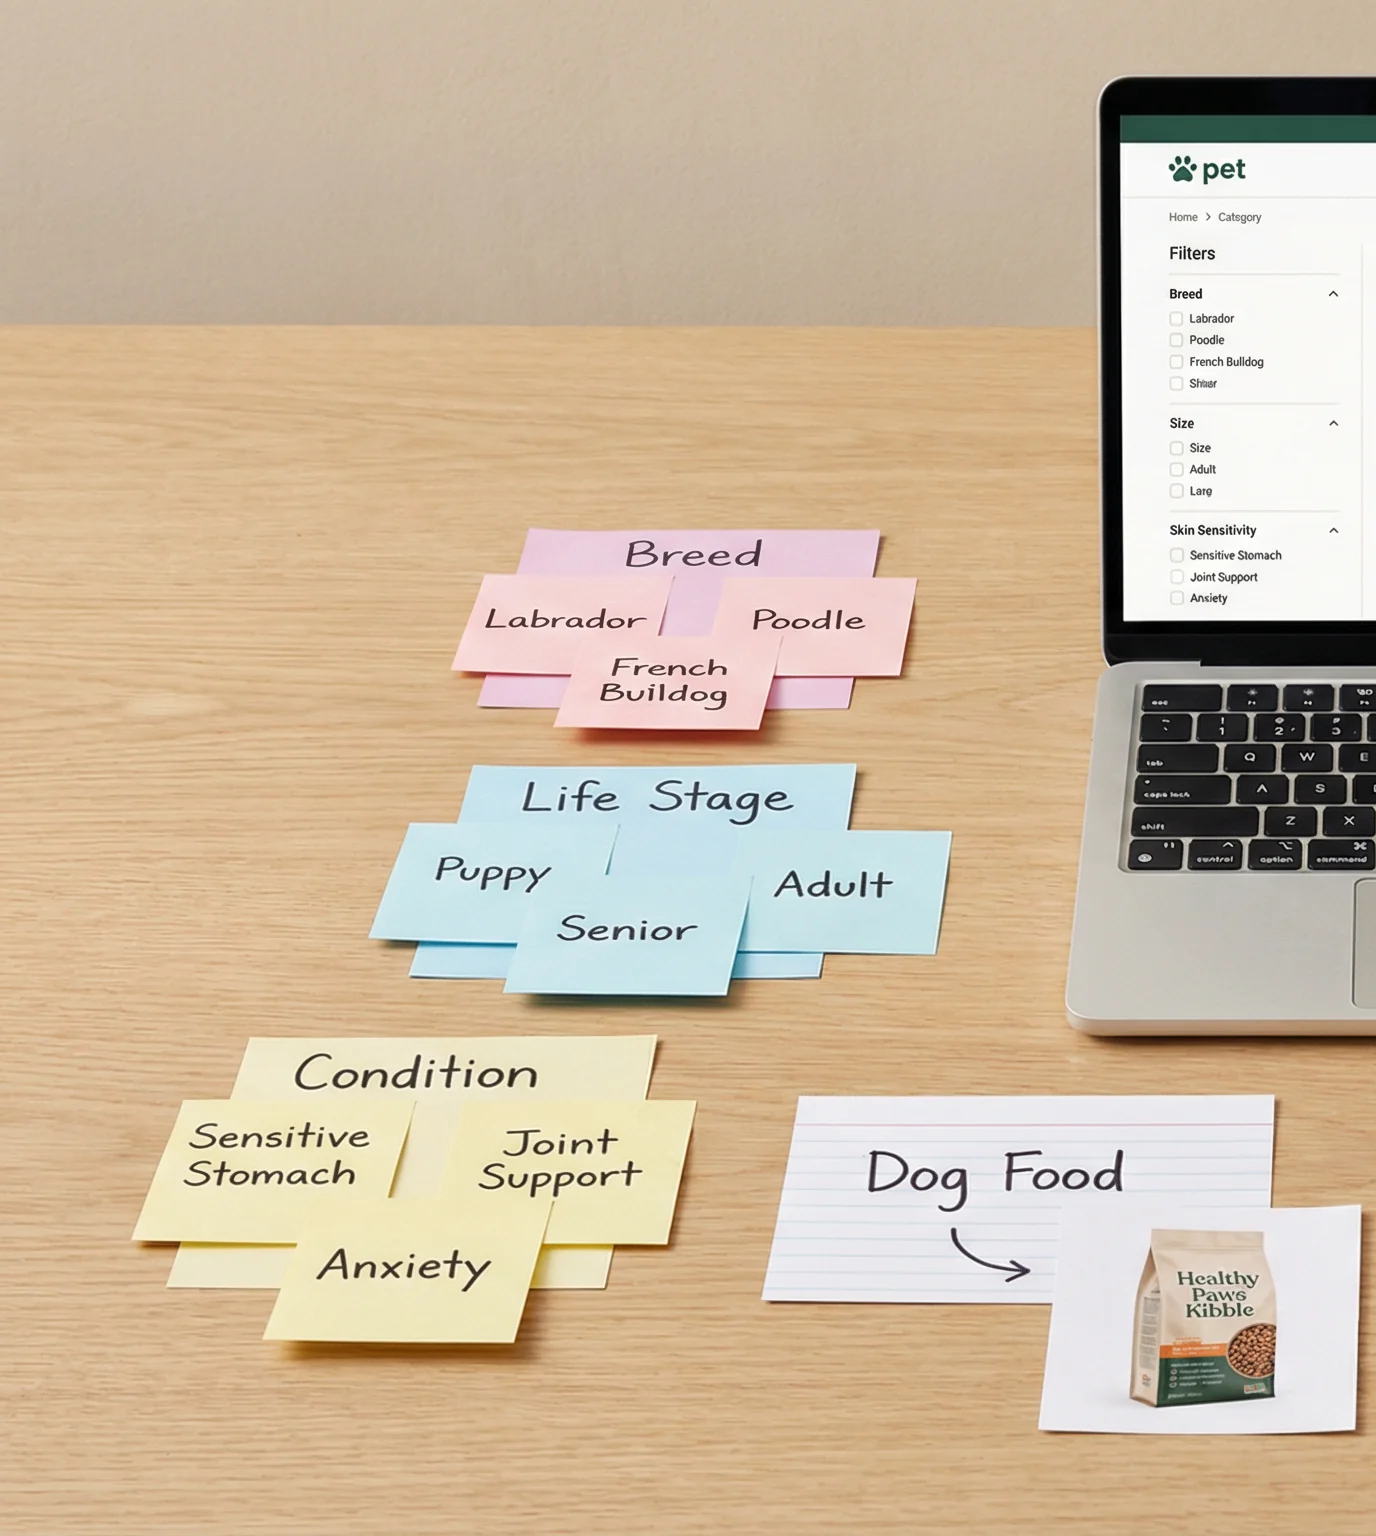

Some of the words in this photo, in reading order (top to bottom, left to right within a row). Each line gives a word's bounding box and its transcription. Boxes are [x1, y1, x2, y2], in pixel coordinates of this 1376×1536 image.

[1203, 159, 1245, 185] pet
[1169, 212, 1199, 222] Home
[1170, 246, 1215, 260] Filters
[1169, 287, 1203, 300] Breed
[1189, 312, 1235, 324] Labrador
[1189, 356, 1224, 367] French
[1226, 356, 1264, 370] Bulldog
[1169, 417, 1195, 429] Size
[1189, 442, 1212, 454] Size
[1189, 463, 1217, 475] Adult
[1169, 523, 1195, 536] Skin
[1197, 524, 1257, 539] Sensitivity
[626, 539, 762, 567] Breed
[1189, 549, 1236, 561] Sensitive
[1189, 571, 1217, 583] Joint
[1217, 571, 1258, 585] Support
[485, 608, 647, 628] Labrador
[753, 609, 865, 630] Poodle
[612, 658, 727, 676] French
[1219, 726, 1225, 736] 1
[1274, 726, 1284, 736] 2
[1244, 752, 1256, 762] Q
[1299, 752, 1316, 762] W
[1359, 752, 1369, 762] E
[1315, 783, 1326, 794] S
[523, 780, 619, 811] Life
[649, 780, 794, 825] Stage
[1285, 815, 1296, 826] Z
[1344, 815, 1355, 826] X
[436, 857, 552, 893] Puppy
[774, 870, 893, 898] Adult
[557, 915, 698, 941] Senior
[295, 1053, 537, 1090] Condition
[189, 1122, 369, 1149] Sensitive
[503, 1129, 618, 1156] Joint
[184, 1160, 355, 1186] Stomach
[478, 1161, 643, 1197] Support
[868, 1150, 967, 1212] Dog
[1005, 1150, 1123, 1191] Food
[316, 1248, 491, 1292] Anxiety
[1177, 1271, 1259, 1288] Healthy
[1187, 1303, 1254, 1317] Kibble
